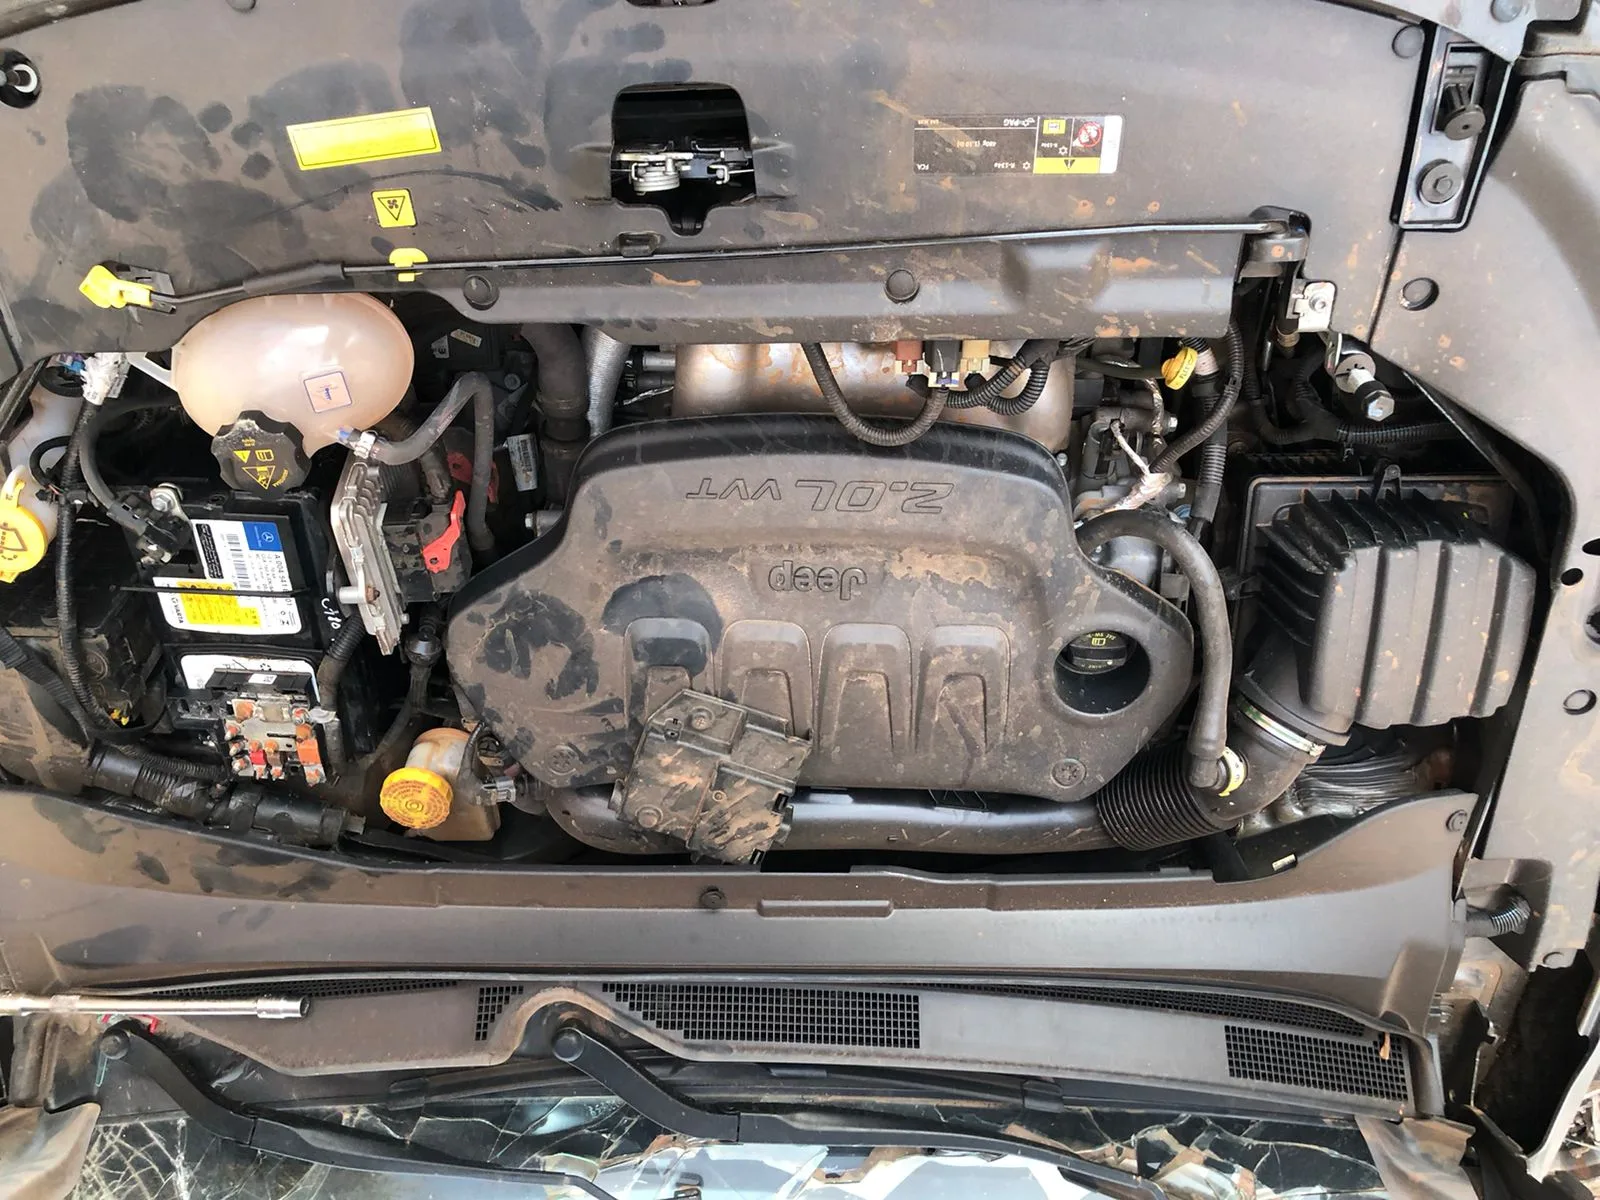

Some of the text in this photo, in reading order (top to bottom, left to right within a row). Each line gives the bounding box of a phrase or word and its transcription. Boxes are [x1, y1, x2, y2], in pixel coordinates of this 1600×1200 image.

[1003, 119, 1019, 127] PAG
[686, 478, 954, 514] 2.0L VVT
[768, 560, 867, 601] Jeep
[173, 603, 184, 624] VARTA
